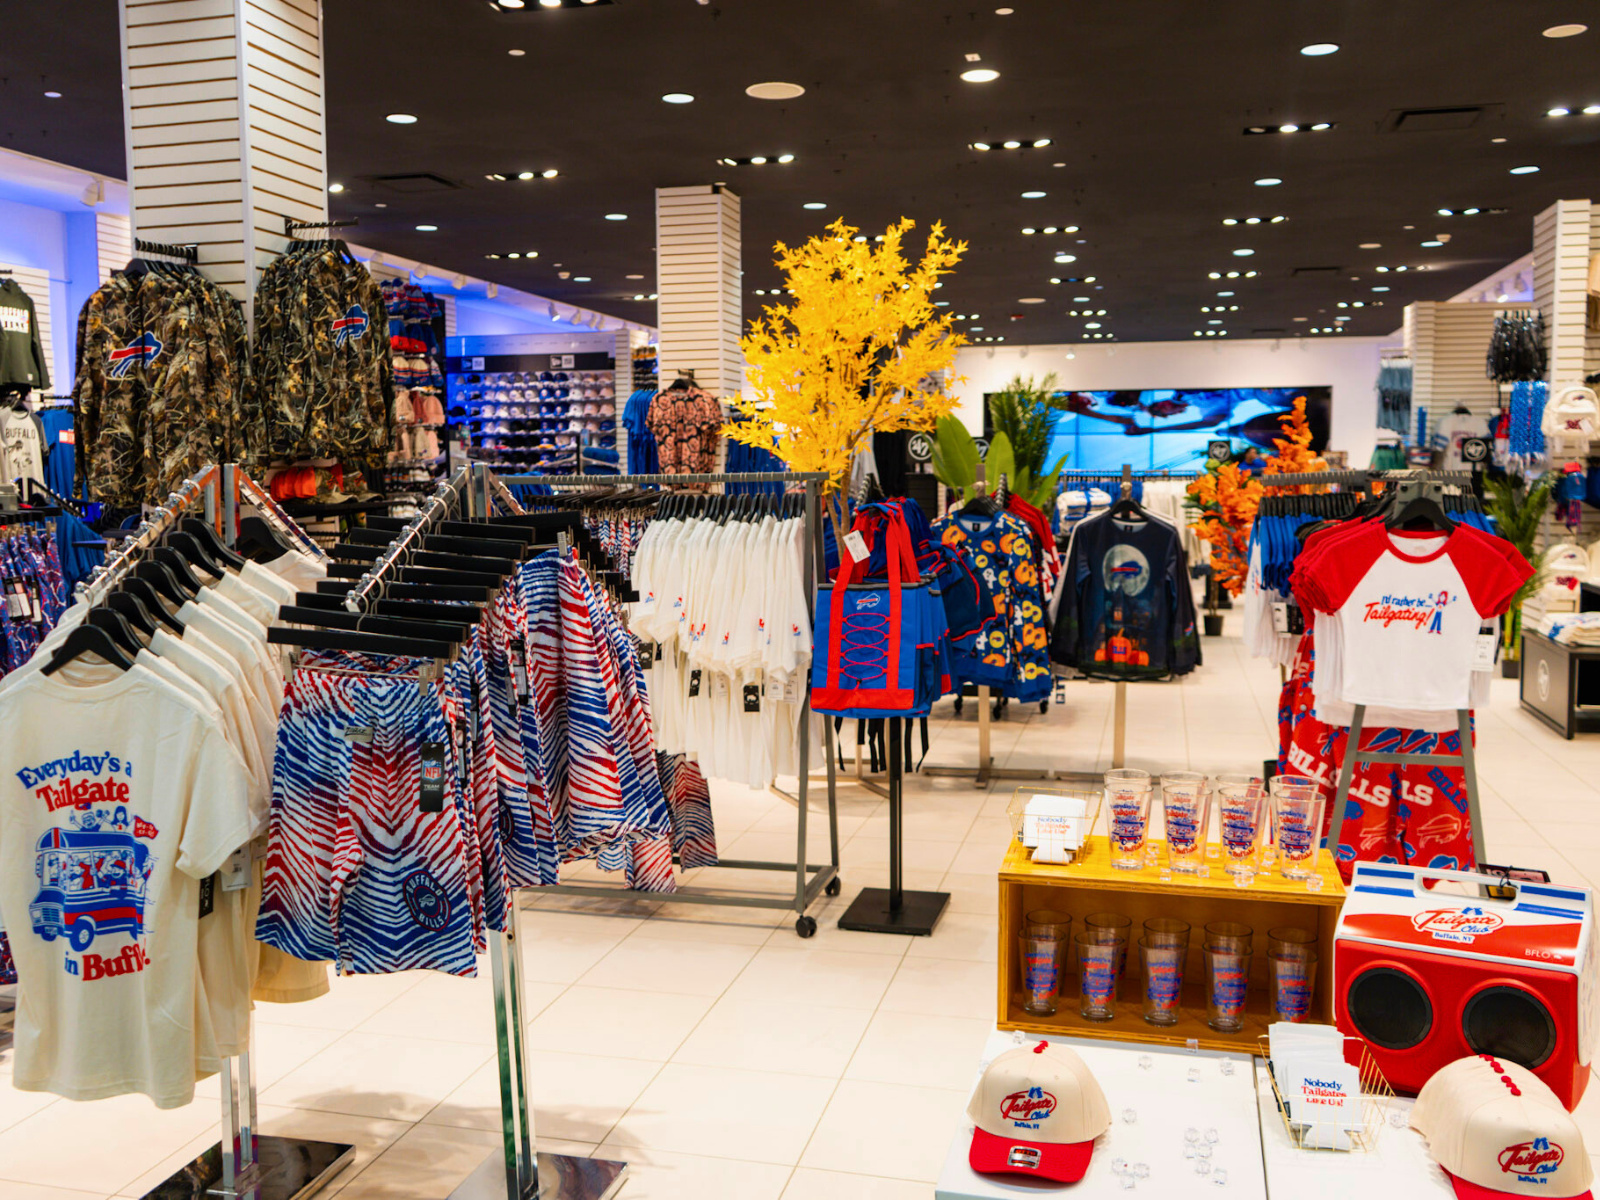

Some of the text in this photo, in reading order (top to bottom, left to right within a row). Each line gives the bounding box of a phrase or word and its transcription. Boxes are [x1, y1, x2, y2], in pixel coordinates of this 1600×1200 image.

[5, 427, 36, 440] BUFFALO
[1392, 596, 1416, 607] rather
[1364, 602, 1435, 630] Tailgating!
[15, 749, 121, 790] Everyday's
[425, 766, 442, 779] NFL
[36, 776, 130, 812] Tailgate
[1427, 766, 1468, 814] BILLS
[406, 874, 444, 896] BUFFALO
[419, 913, 445, 928] BILLS
[1417, 910, 1497, 930] Tailgate
[1460, 924, 1490, 933] Club
[1525, 949, 1550, 959] BFLO
[64, 951, 79, 976] in
[1301, 1086, 1347, 1097] Tailgates
[1304, 1078, 1342, 1091] Nobody
[1002, 1095, 1053, 1119] Tailgate
[1031, 1109, 1050, 1120] Club
[1501, 1146, 1561, 1173] Tailgate
[1536, 1162, 1558, 1174] Club
